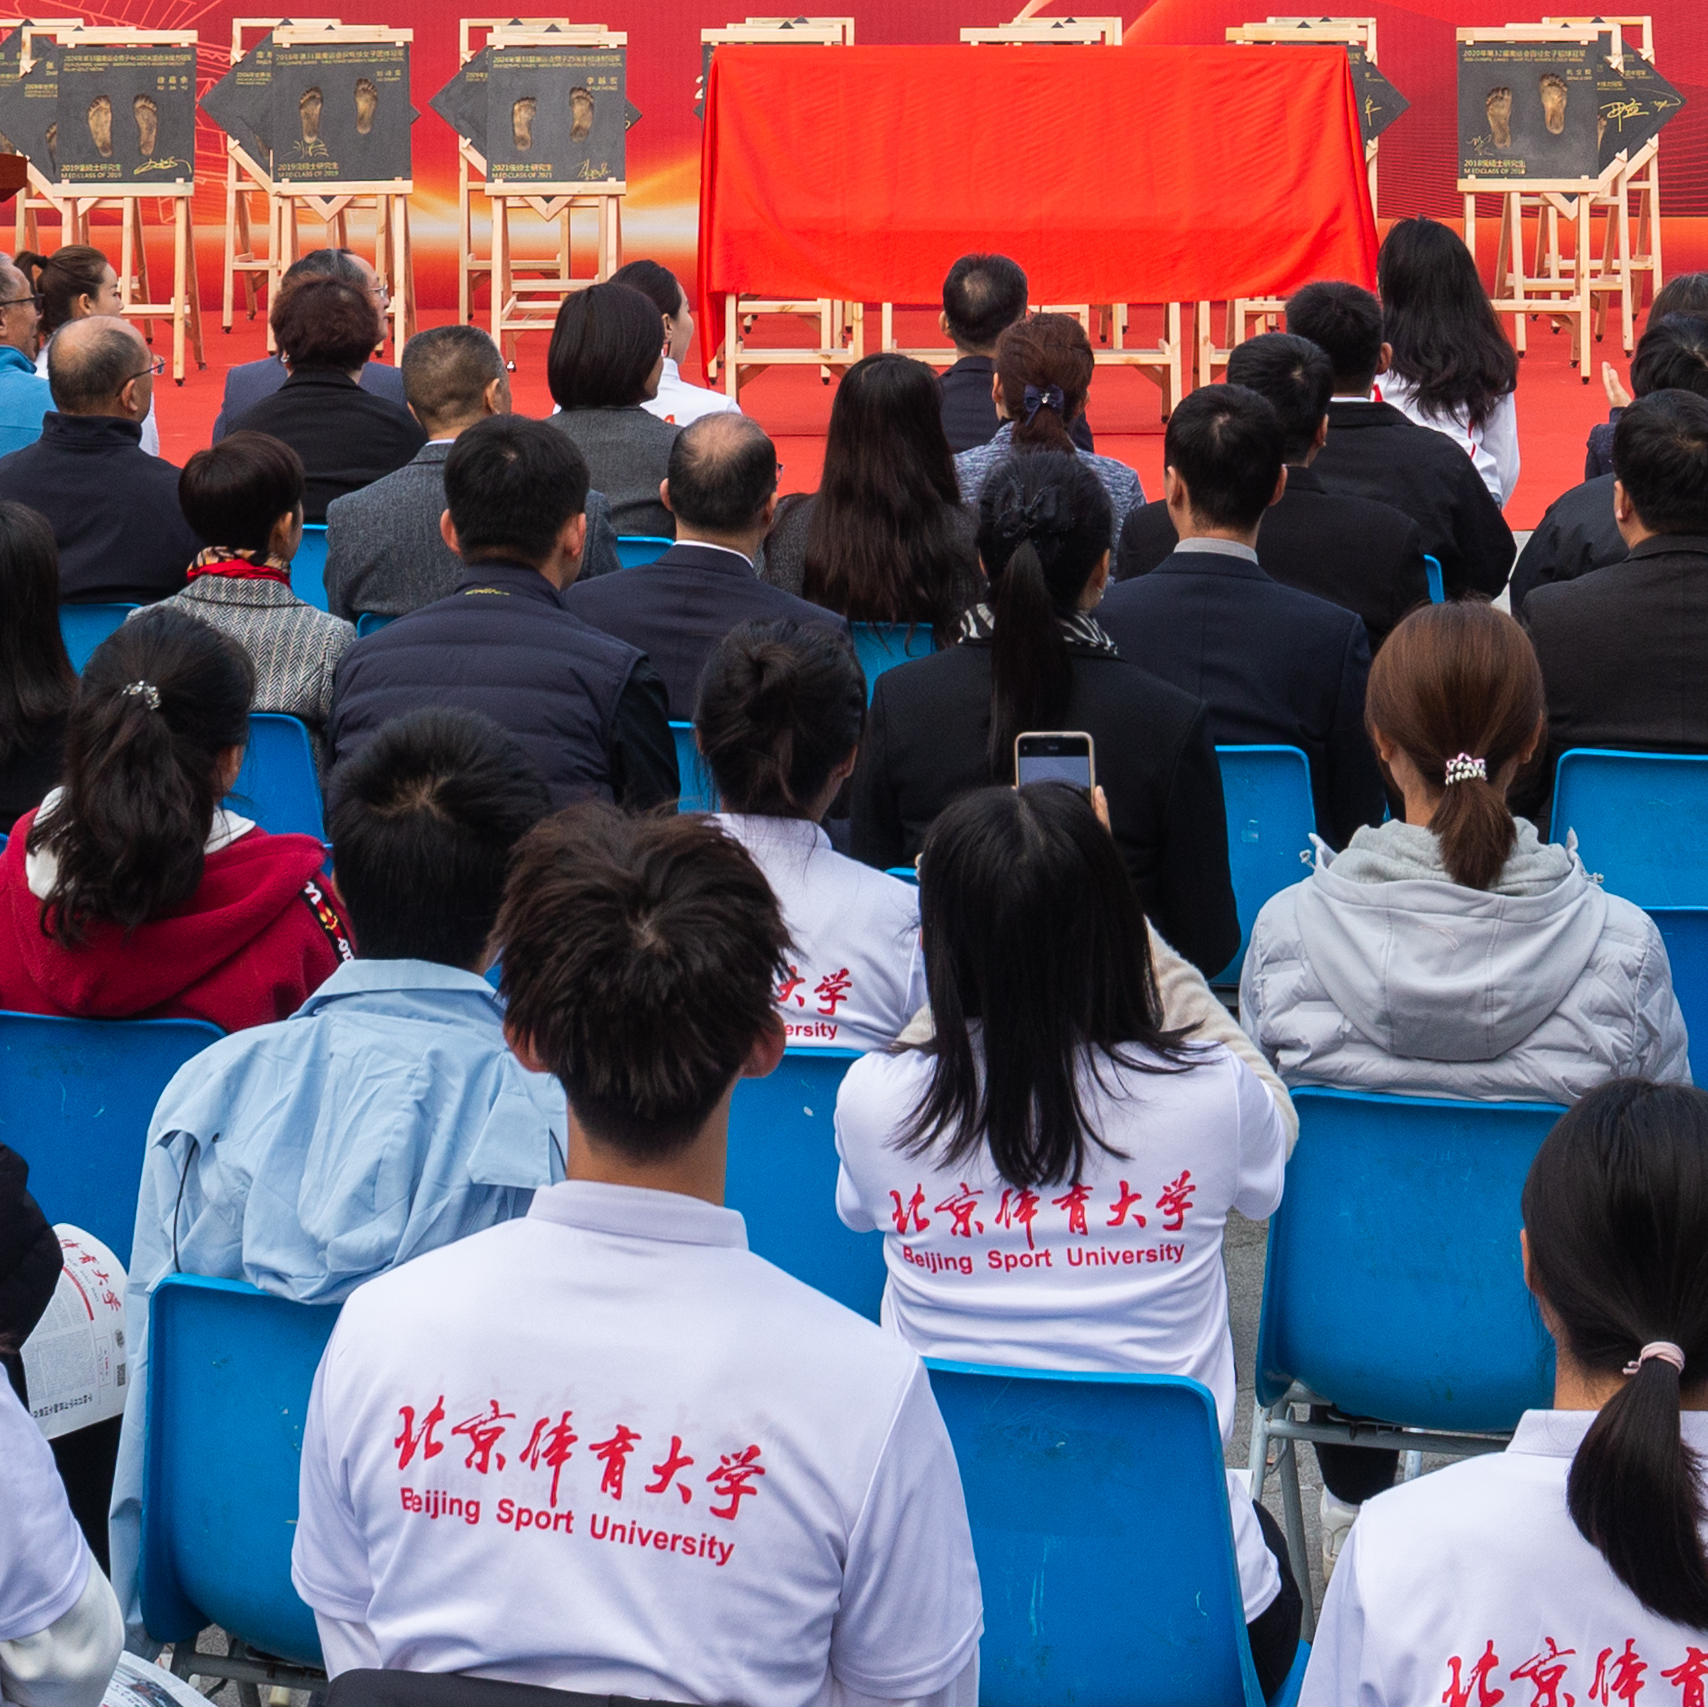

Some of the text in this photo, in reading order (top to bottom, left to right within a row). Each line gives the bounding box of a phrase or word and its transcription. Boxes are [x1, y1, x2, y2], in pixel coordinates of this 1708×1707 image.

[888, 1169, 1197, 1251] 北京体育大学
[902, 1242, 1185, 1275] Beijing Sport University
[394, 1395, 766, 1521] 北京体育大学
[399, 1486, 736, 1568] Beijing Sport University
